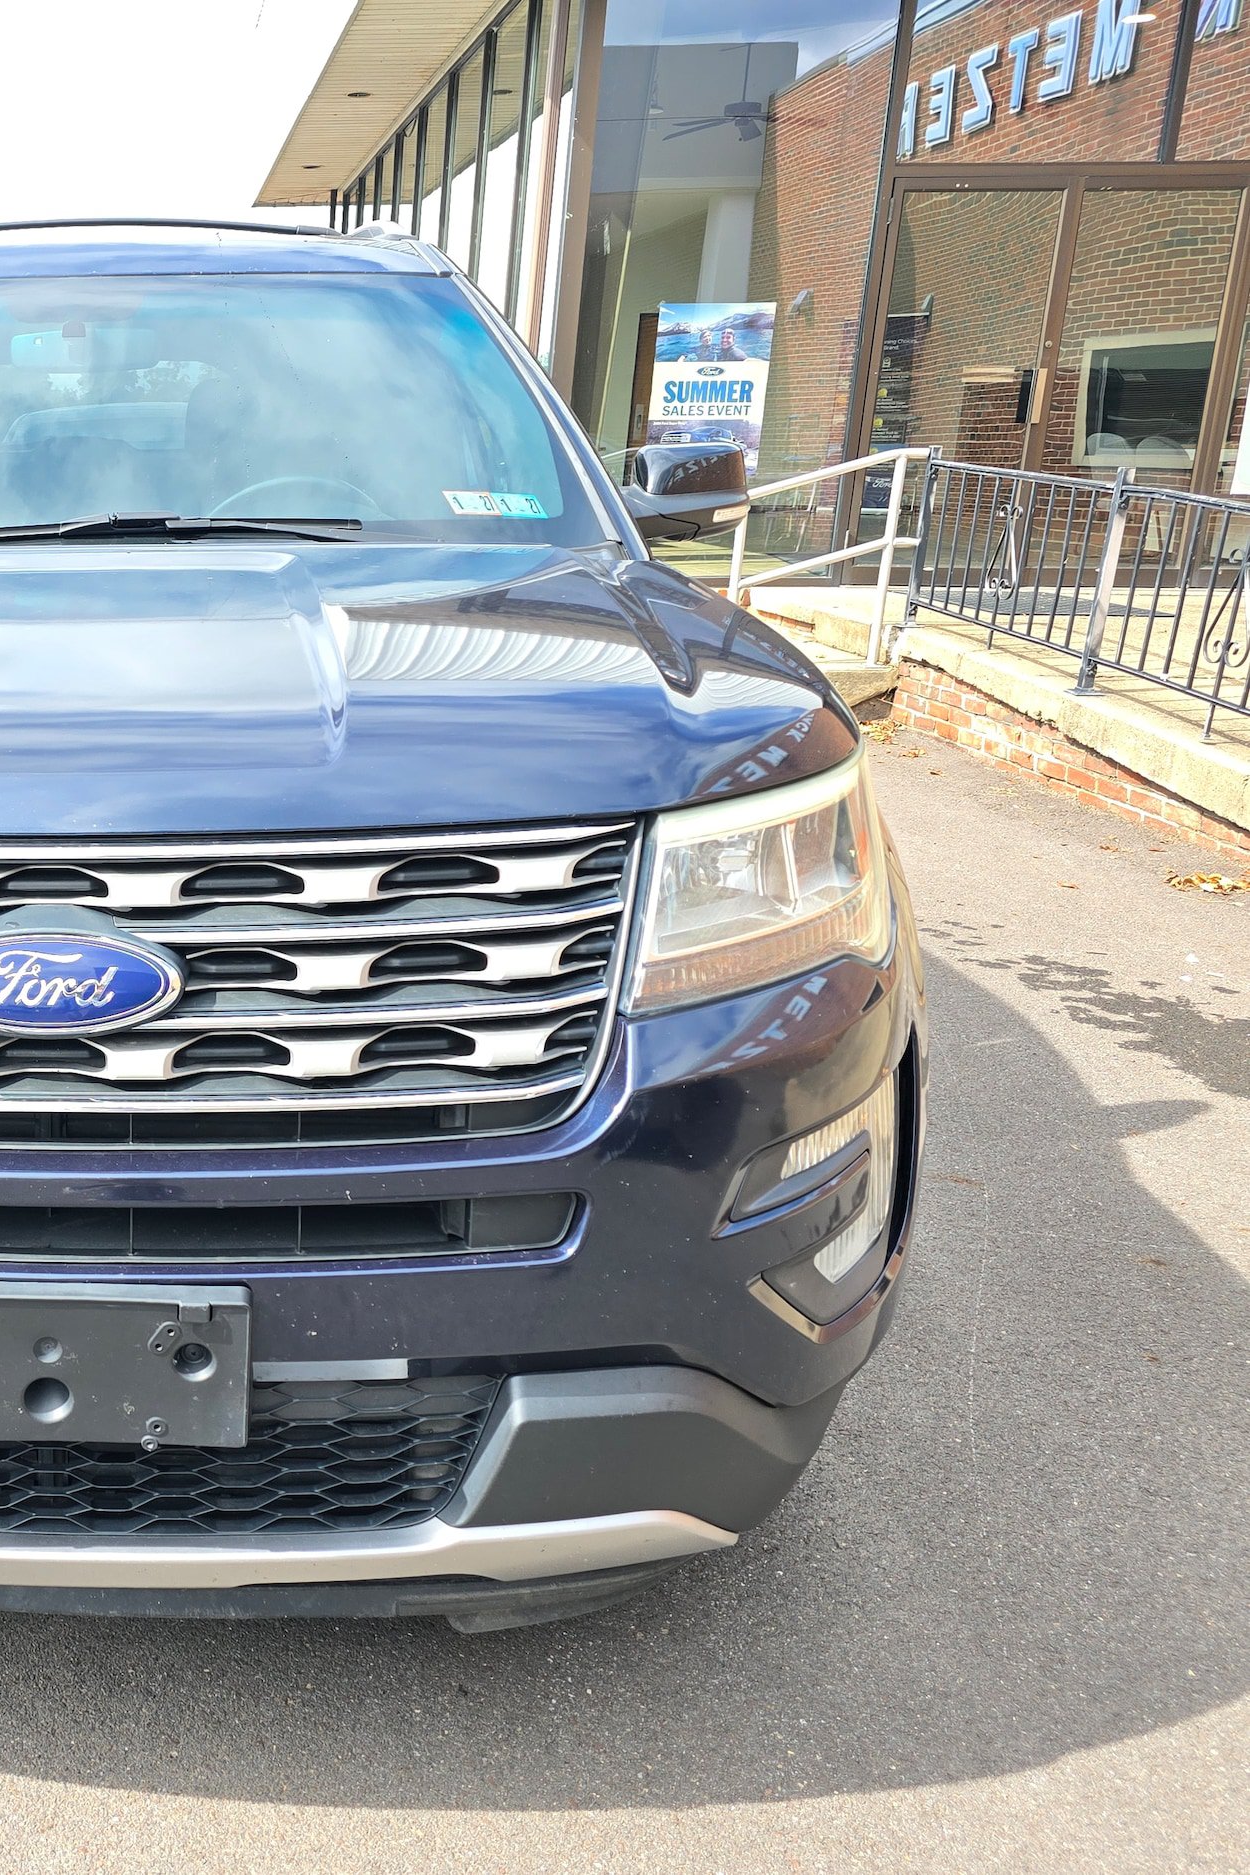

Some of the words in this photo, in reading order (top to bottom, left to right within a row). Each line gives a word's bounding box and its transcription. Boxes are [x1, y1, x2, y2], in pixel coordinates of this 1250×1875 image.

[699, 366, 723, 377] Ford
[662, 380, 754, 404] SUMMER
[662, 405, 705, 417] SALES
[707, 405, 752, 416] EVENT
